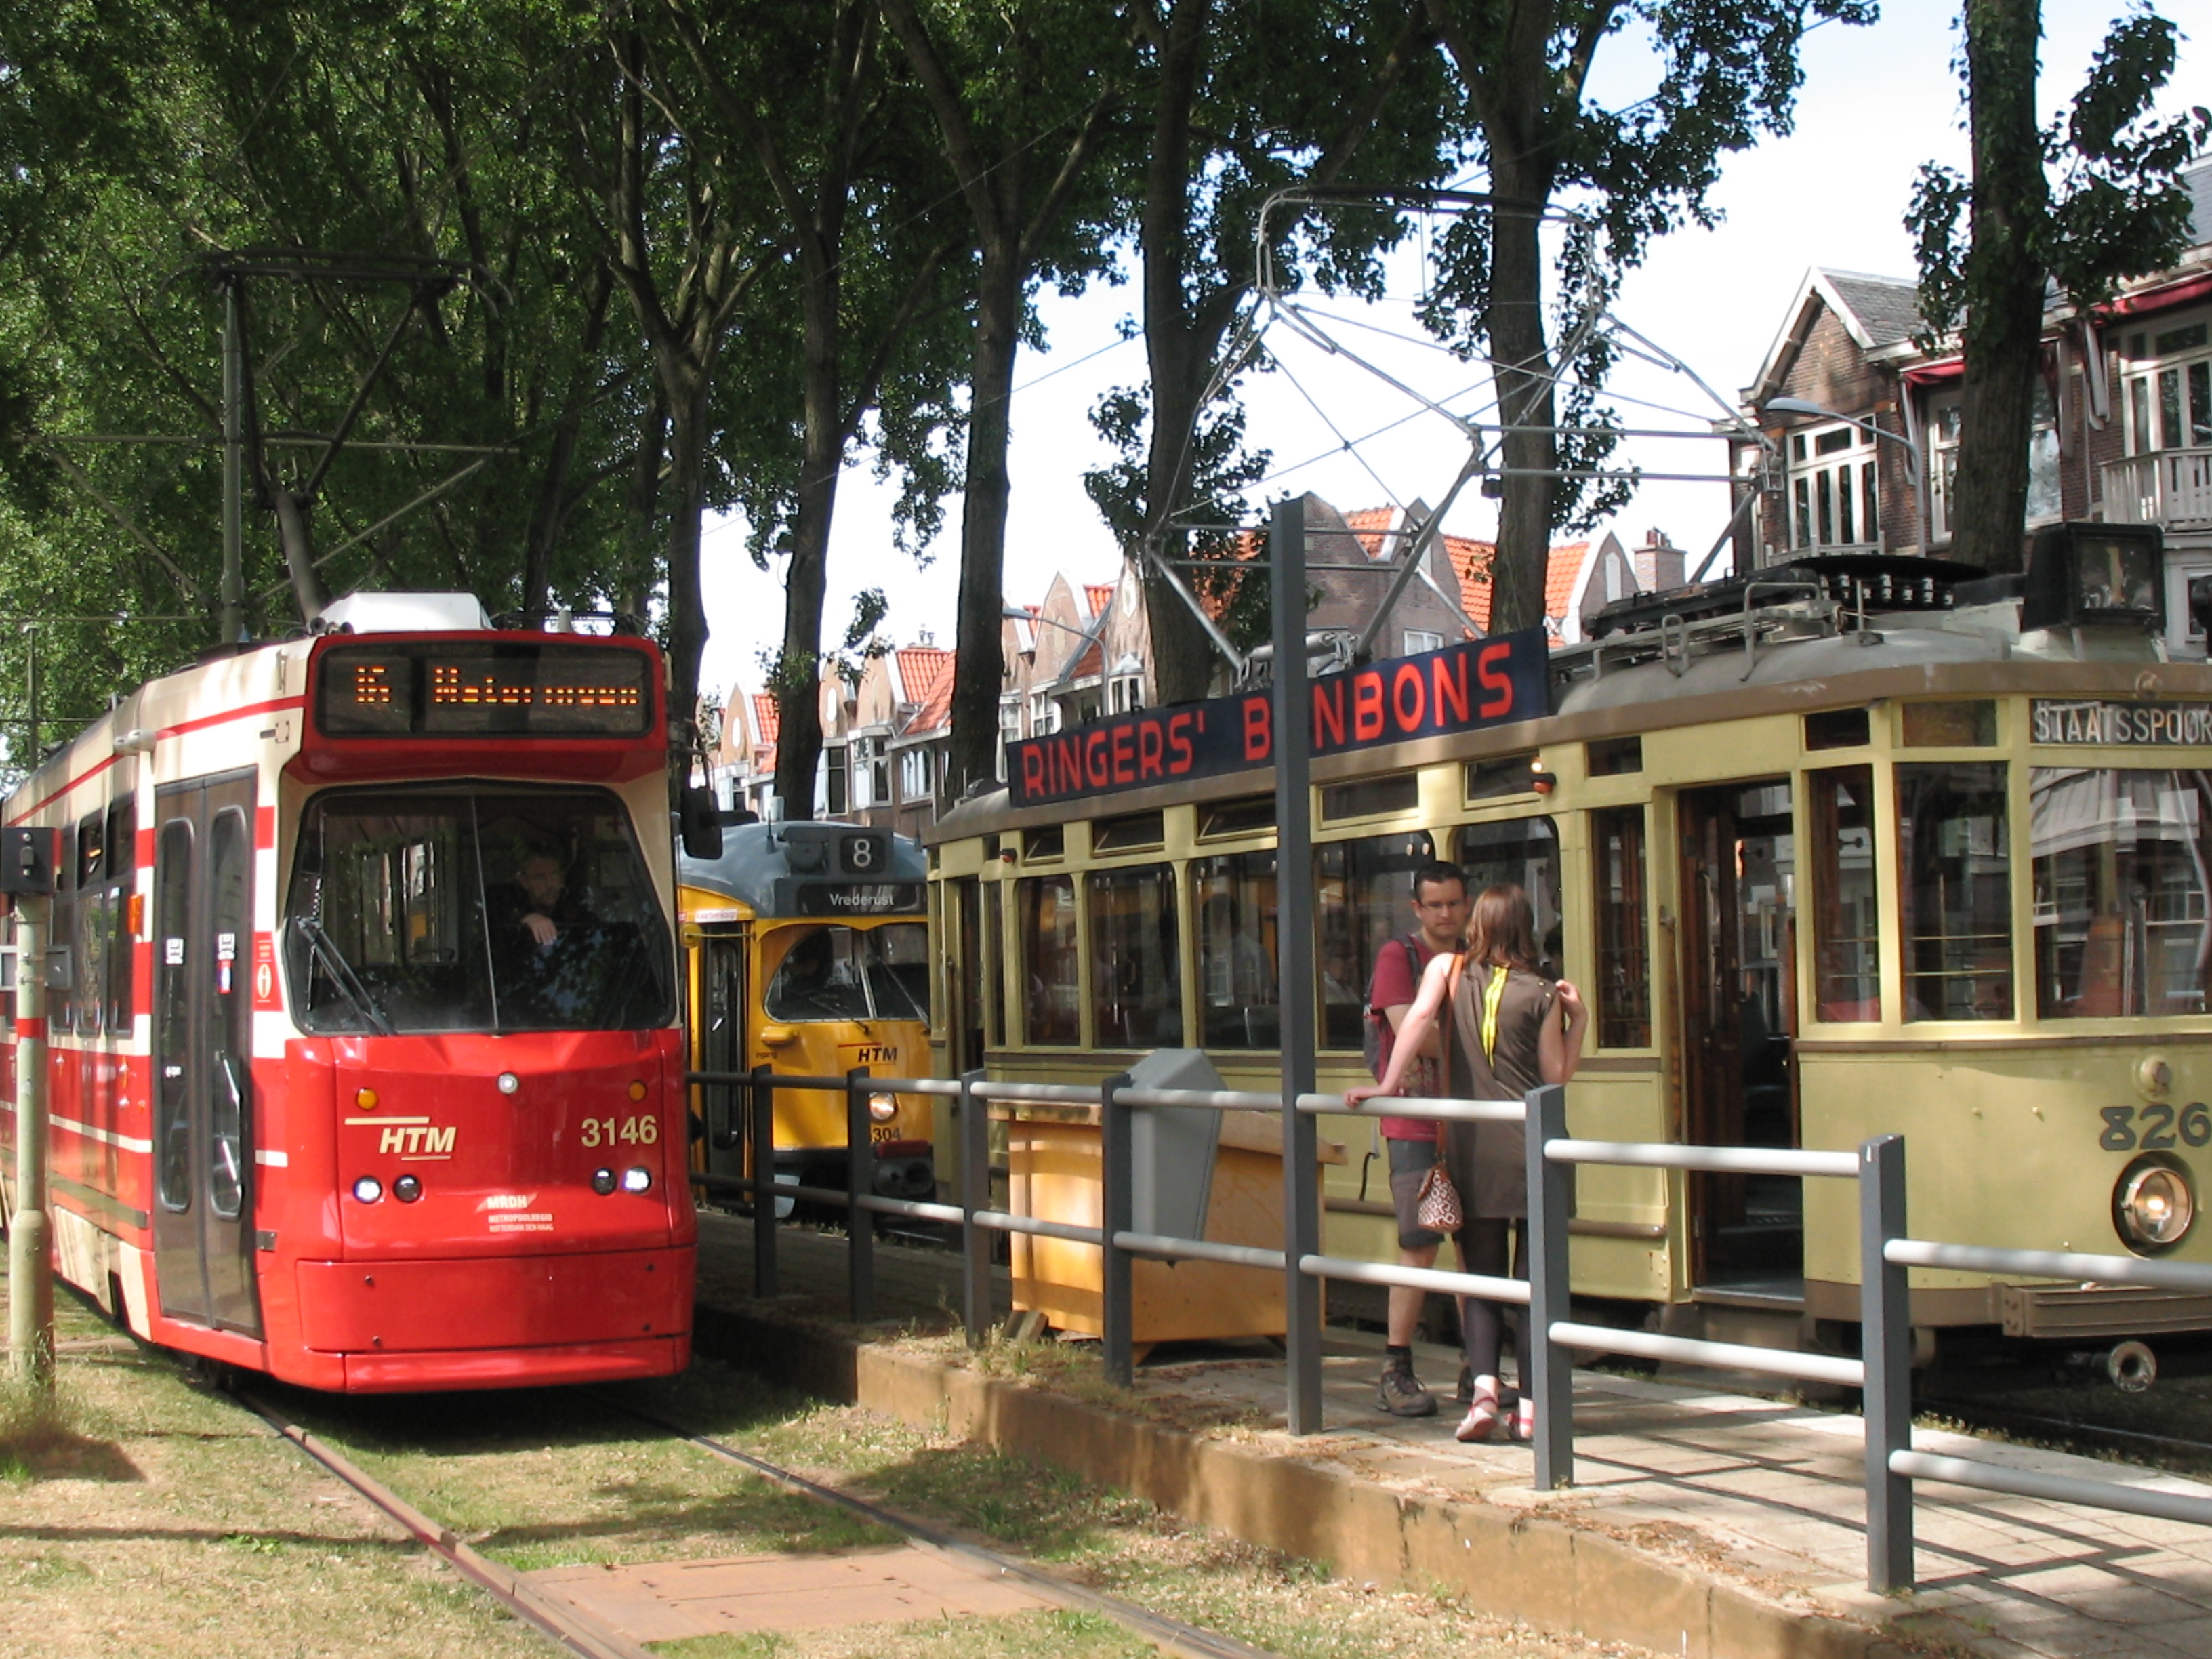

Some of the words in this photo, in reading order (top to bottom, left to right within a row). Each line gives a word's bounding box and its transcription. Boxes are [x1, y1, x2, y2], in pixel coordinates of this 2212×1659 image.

[1021, 712, 1206, 801] RINGERS'
[1242, 642, 1515, 762] BNBONS
[852, 838, 872, 868] 8
[830, 893, 895, 906] Vrederust
[857, 1047, 898, 1063] HTM
[379, 1126, 457, 1155] HTM
[581, 1115, 658, 1148] 3146
[2099, 1101, 2212, 1151] 826
[487, 1195, 528, 1210] MRDH
